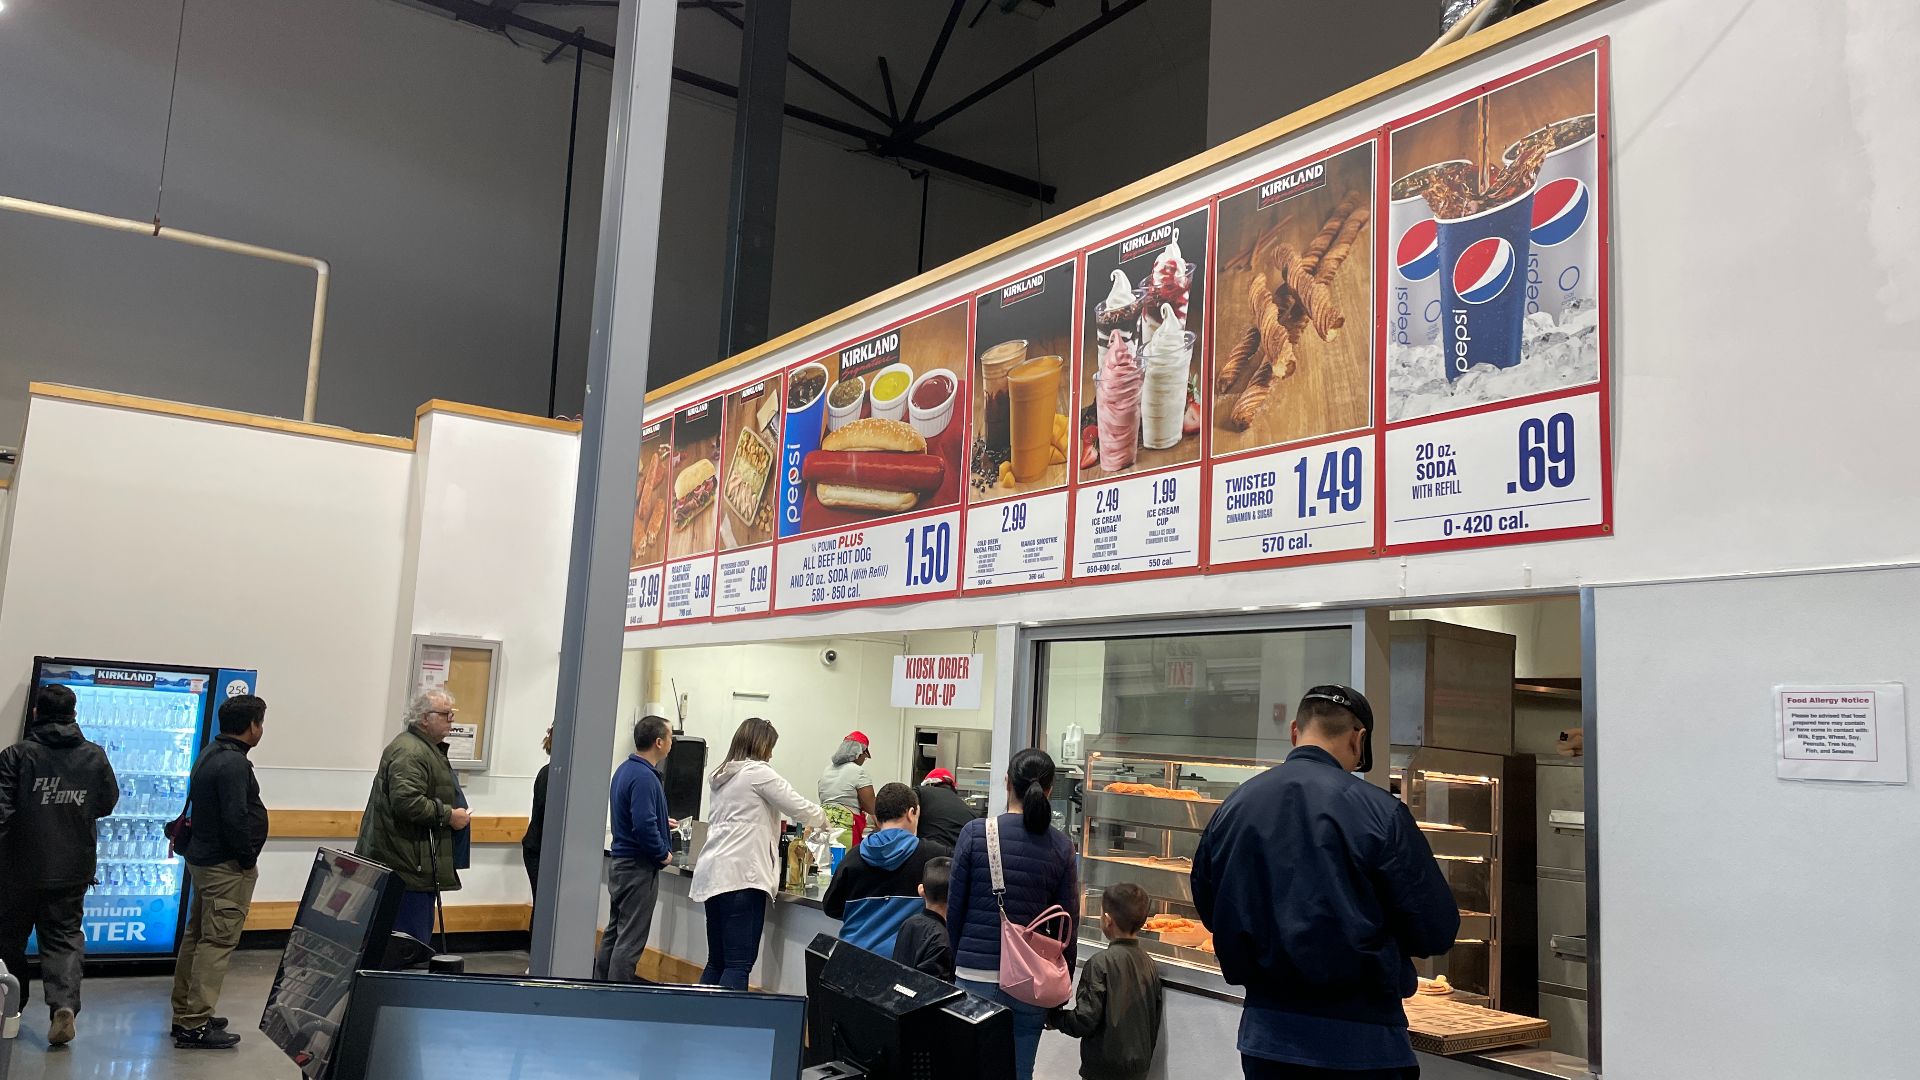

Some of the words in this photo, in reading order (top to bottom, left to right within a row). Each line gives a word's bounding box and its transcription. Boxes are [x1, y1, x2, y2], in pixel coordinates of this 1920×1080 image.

[1261, 164, 1324, 199] KIRKLAND
[1122, 225, 1171, 254] KIRKLAND
[1003, 274, 1044, 299] KIRKLAND
[1395, 287, 1411, 345] pepsi
[842, 334, 898, 369] KIRKLAND
[1452, 309, 1473, 372] pepsi
[1415, 443, 1434, 461] 20
[1437, 444, 1457, 458] oz.
[1507, 412, 1576, 494] .69
[1416, 459, 1457, 481] SODA
[787, 444, 802, 523] pepsi
[1153, 477, 1177, 505] 1.99
[1225, 471, 1276, 494] TWISTED
[1294, 446, 1363, 519] 1.49
[1412, 483, 1433, 500] WITH
[1435, 480, 1462, 497] REFILL
[1096, 488, 1119, 514] 2.49
[1226, 489, 1274, 511] CHURRO
[1002, 502, 1027, 533] 2.99
[1092, 518, 1101, 526] ICE
[1101, 514, 1122, 525] CREAM
[1147, 509, 1156, 518] ICE
[1157, 505, 1180, 516] CREAM
[1156, 517, 1169, 527] CUP
[1226, 512, 1251, 524] CINNAMON
[1257, 508, 1273, 520] SUGAR
[1498, 511, 1529, 531] cal.
[1095, 525, 1117, 534] SUNDAE
[818, 539, 837, 552] POUND
[838, 532, 864, 549] PLUS
[1262, 536, 1284, 553] 570
[1288, 533, 1313, 550] cal.
[803, 557, 816, 571] ALL
[818, 553, 835, 569] BEEF
[837, 550, 852, 565] HOT
[854, 547, 871, 563] DOG
[904, 522, 950, 586] 1.50
[1148, 558, 1161, 567] 550
[1161, 557, 1173, 566] cal.
[750, 565, 767, 592] 6.99
[790, 575, 804, 589] AND
[805, 573, 815, 586] 20
[815, 574, 826, 585] oz.
[828, 568, 849, 583] SODA
[851, 567, 867, 581] (With
[1111, 563, 1122, 572] cal.
[640, 574, 660, 608] 3.99
[695, 574, 710, 599] 9.99
[811, 588, 825, 602] 580
[831, 585, 846, 599] 850
[847, 584, 861, 598] cal.
[97, 670, 154, 682] KIRKLAND
[906, 657, 935, 680] KIOSK
[938, 656, 969, 680] ORDER
[228, 686, 247, 695] 25¢
[915, 683, 956, 706] PICK-UP
[1810, 697, 1839, 705] Allergy
[33, 777, 60, 793] FLY
[41, 790, 87, 806] E-BIKE
[83, 902, 142, 917] mium
[80, 922, 147, 941] TER
